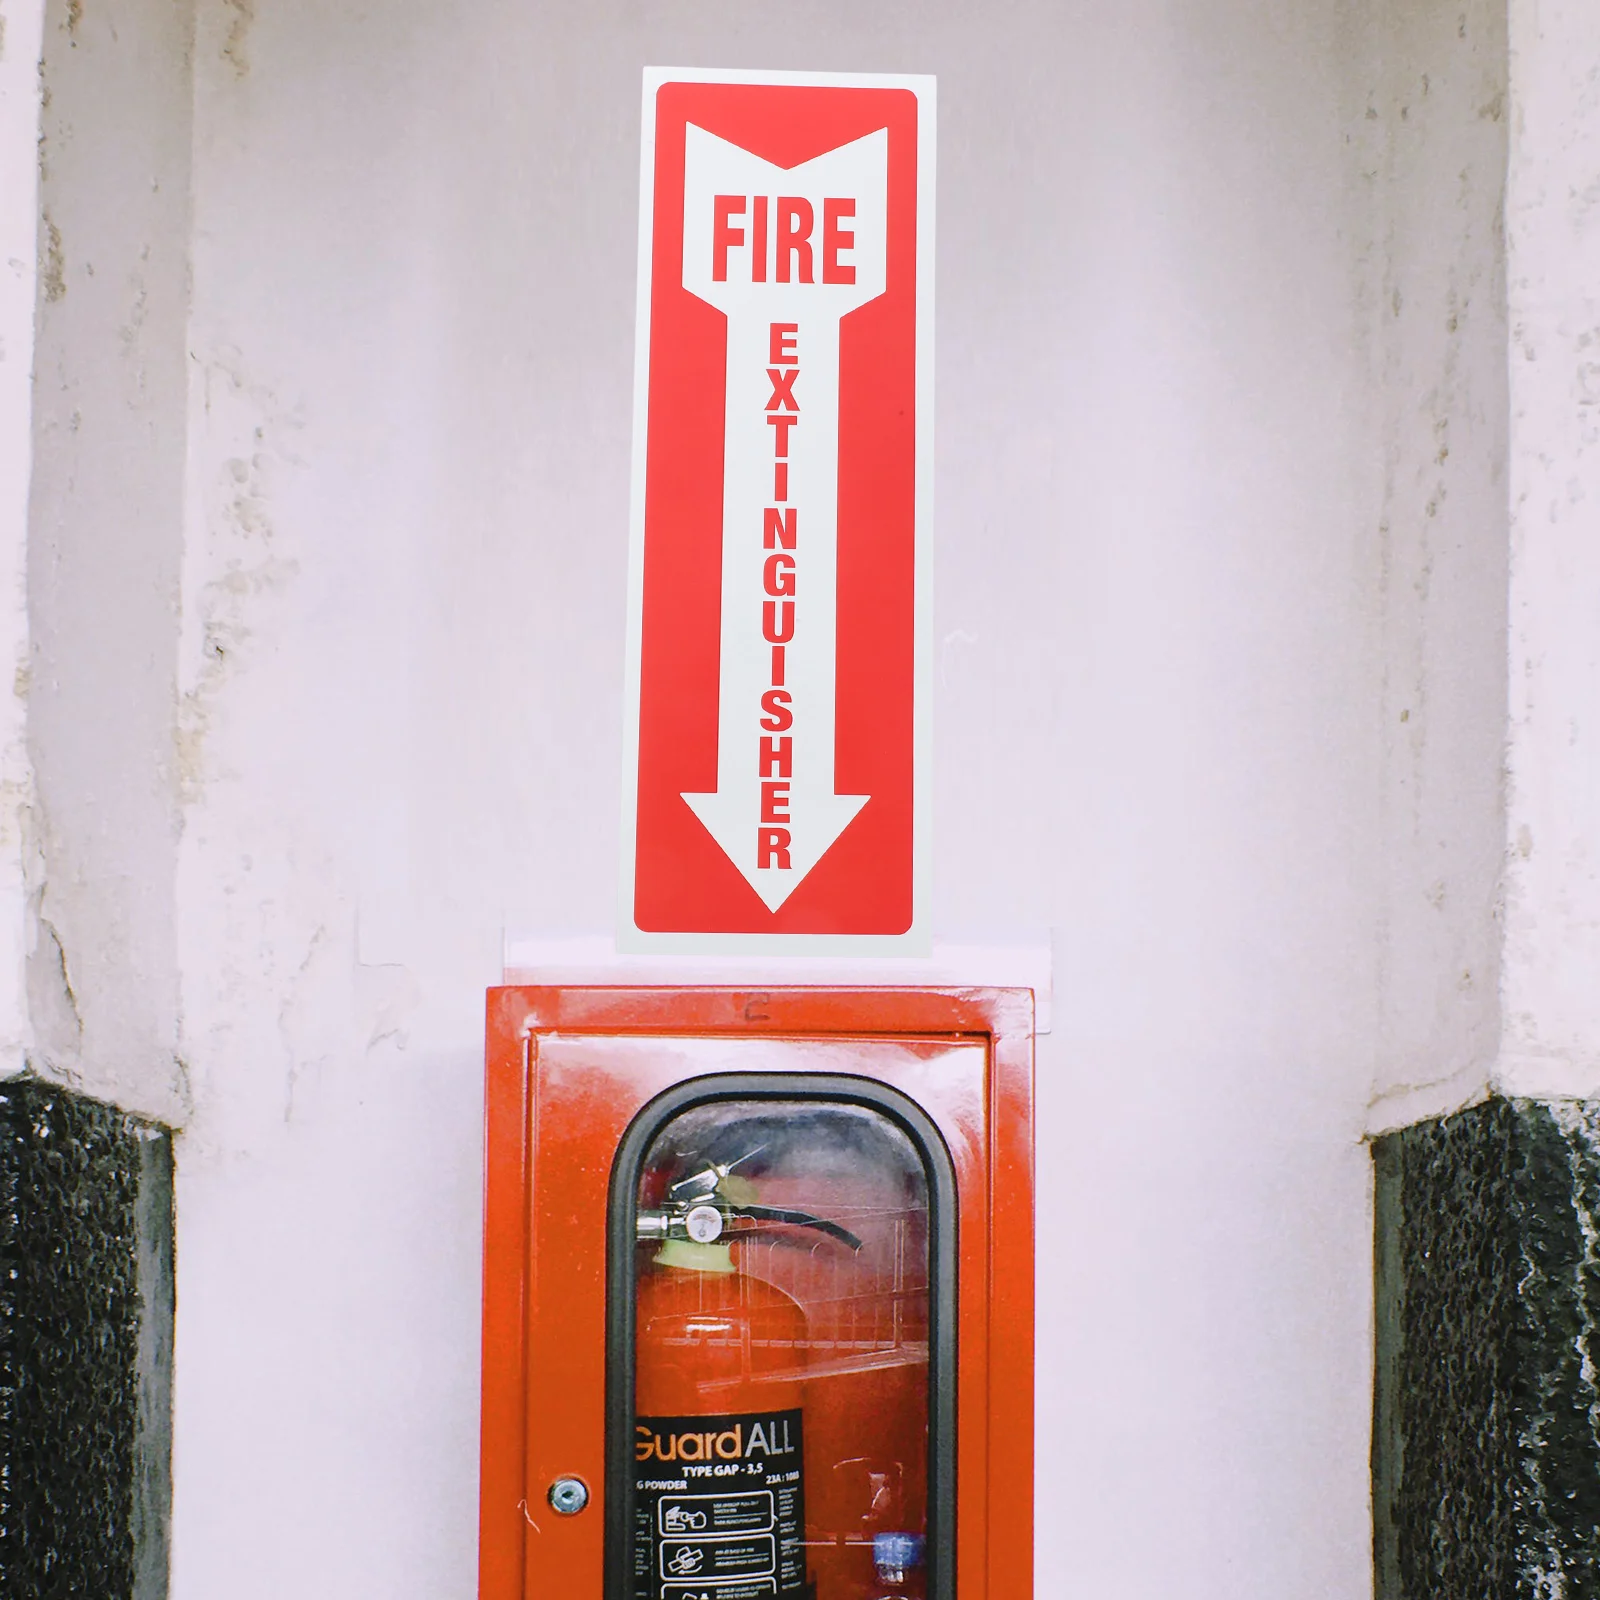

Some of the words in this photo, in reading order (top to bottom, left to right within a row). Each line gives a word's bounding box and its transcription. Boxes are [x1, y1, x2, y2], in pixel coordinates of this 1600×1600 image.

[713, 195, 856, 284] FIRE
[757, 323, 800, 870] EXTINGUISHER
[636, 1420, 794, 1461] GuardALL
[645, 1480, 688, 1490] POWDER
[682, 1465, 713, 1478] TYPE
[714, 1463, 740, 1477] GAP
[747, 1462, 764, 1475] 3,5
